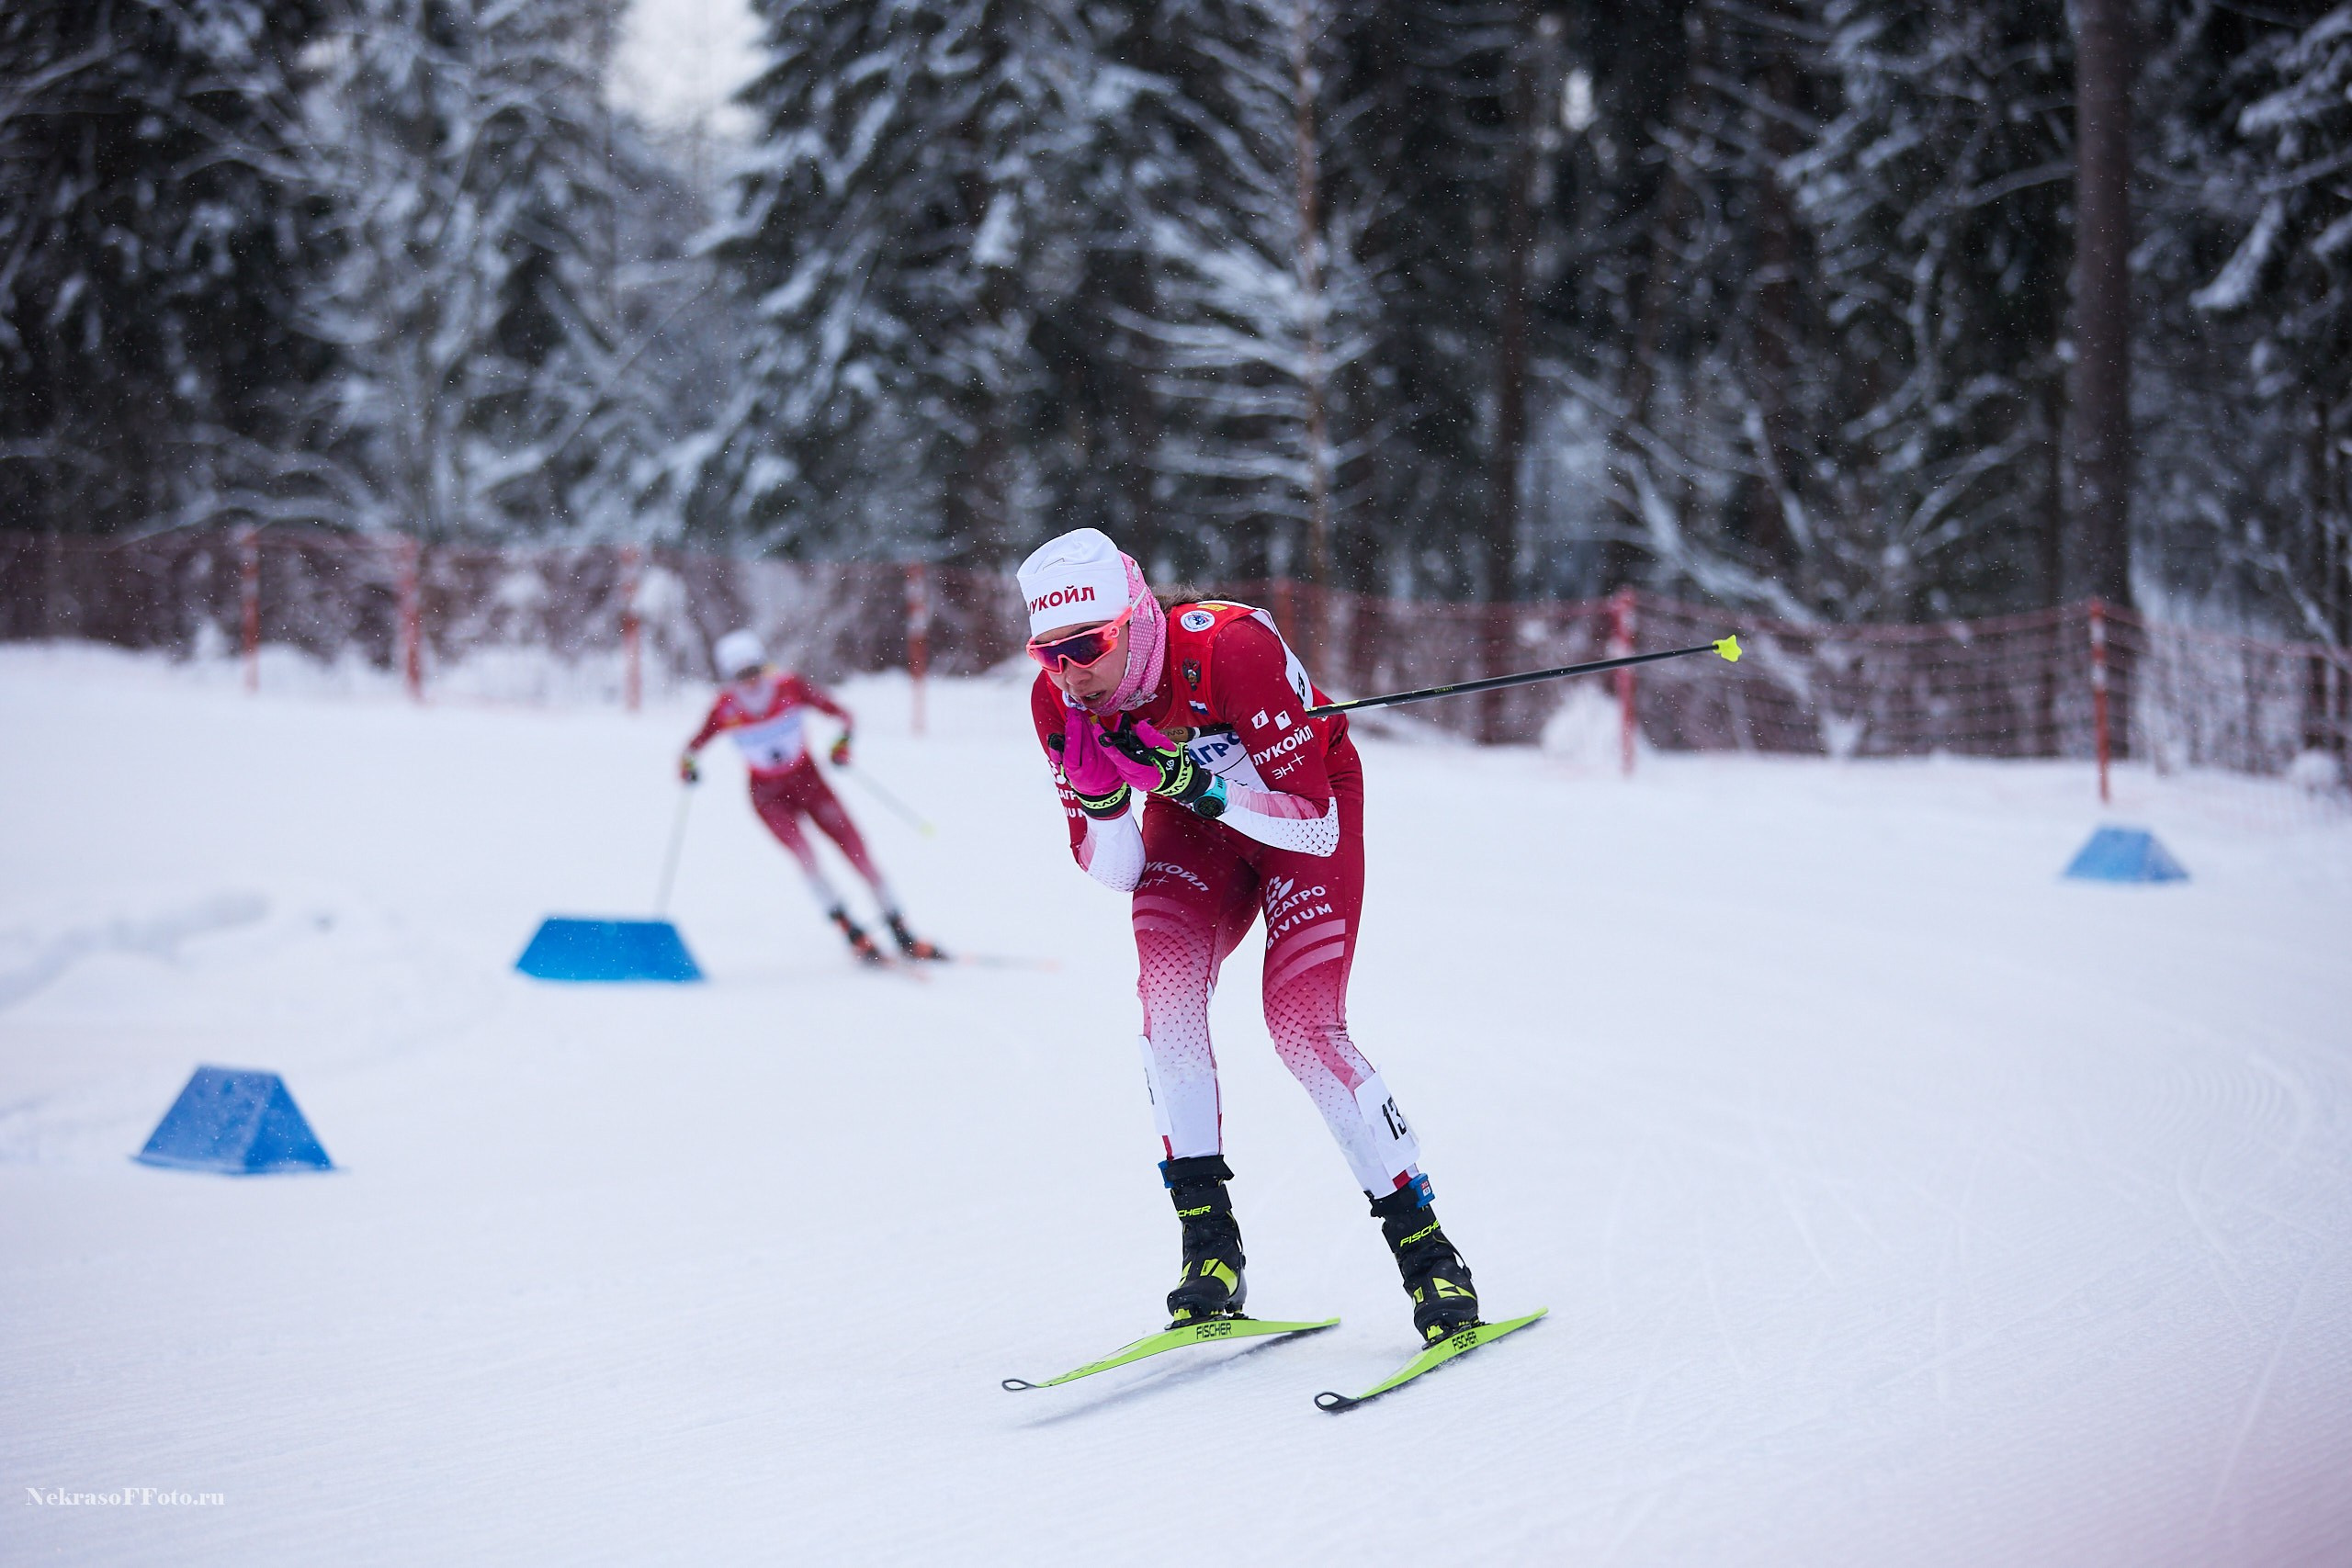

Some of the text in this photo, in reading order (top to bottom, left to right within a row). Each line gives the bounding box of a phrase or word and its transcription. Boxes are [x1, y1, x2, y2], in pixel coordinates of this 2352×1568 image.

[1030, 585, 1095, 615] УКОЙЛ
[1252, 725, 1314, 766] ЛУКОЙЛ
[1267, 903, 1333, 950] BIVIUM
[1382, 1096, 1408, 1141] 13
[1196, 1323, 1232, 1340] FISCHER
[1452, 1330, 1479, 1352] FISCHER
